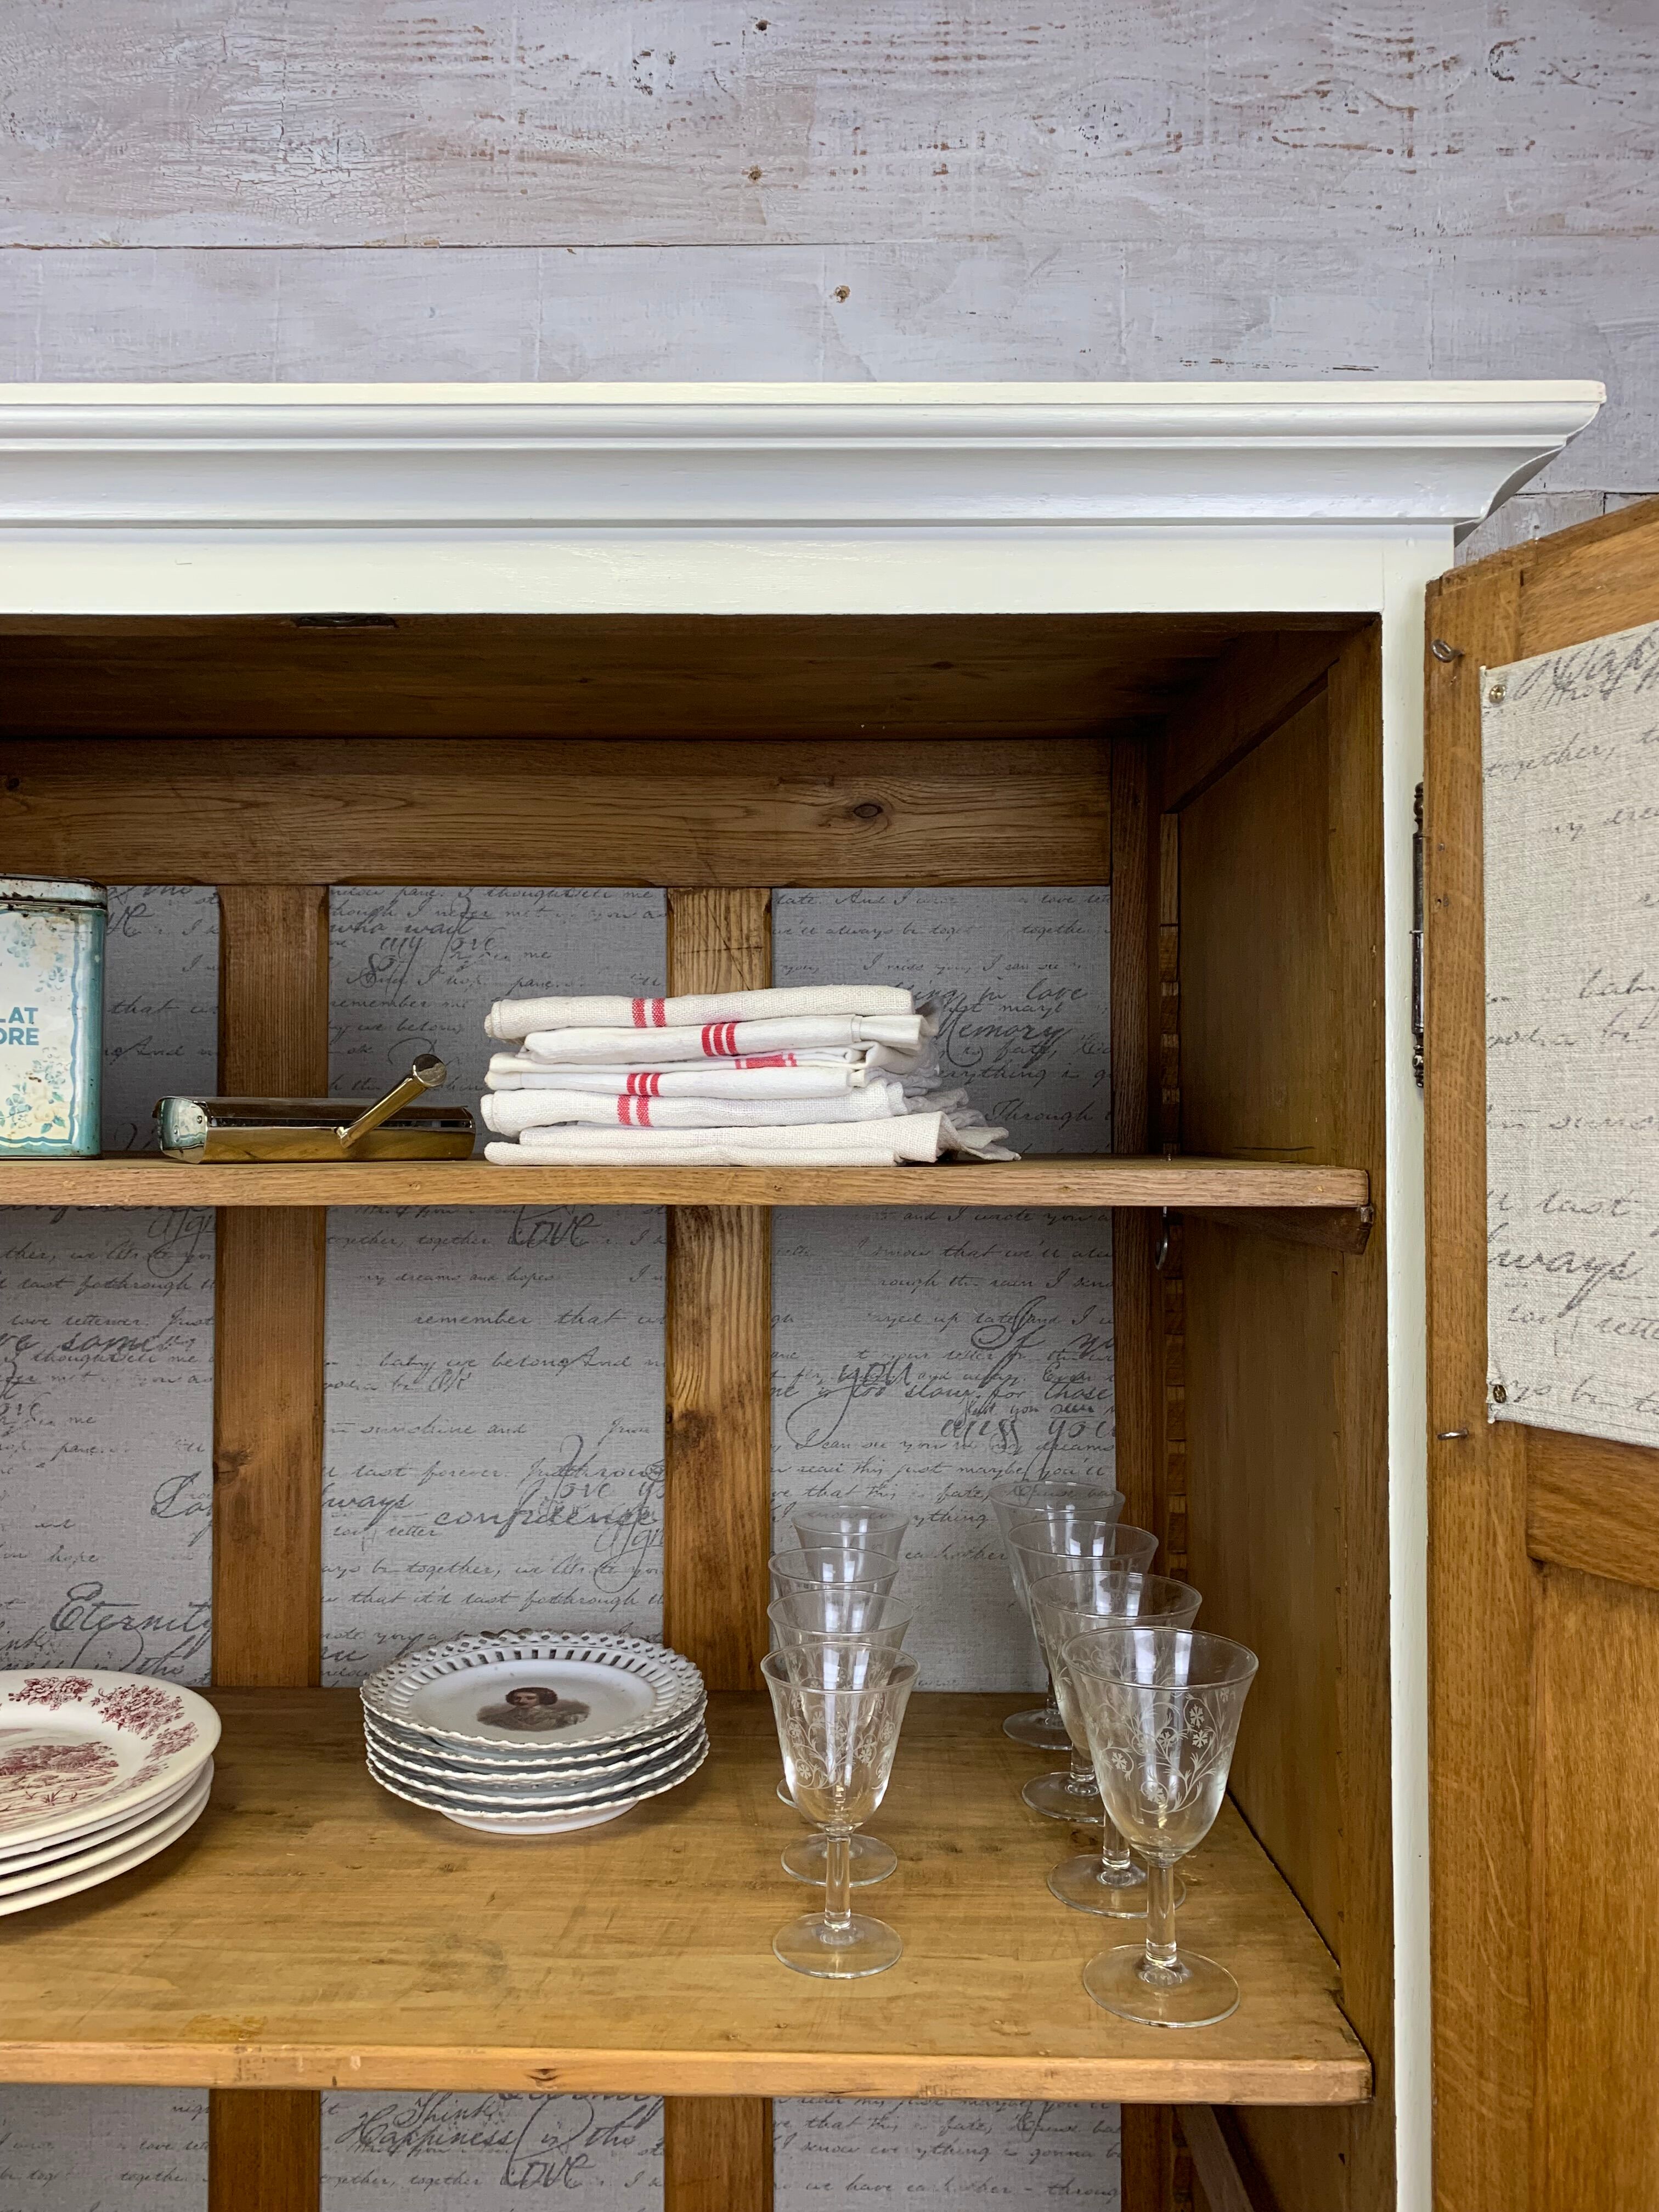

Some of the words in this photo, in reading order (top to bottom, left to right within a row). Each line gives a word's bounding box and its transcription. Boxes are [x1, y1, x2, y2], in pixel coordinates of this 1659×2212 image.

[108, 995, 181, 1015] that
[0, 1007, 39, 1024] AT
[939, 1240, 1003, 1259] that
[412, 1308, 532, 1325] remember
[553, 1304, 628, 1325] that
[347, 1585, 409, 1604] that
[460, 1591, 522, 1605] last
